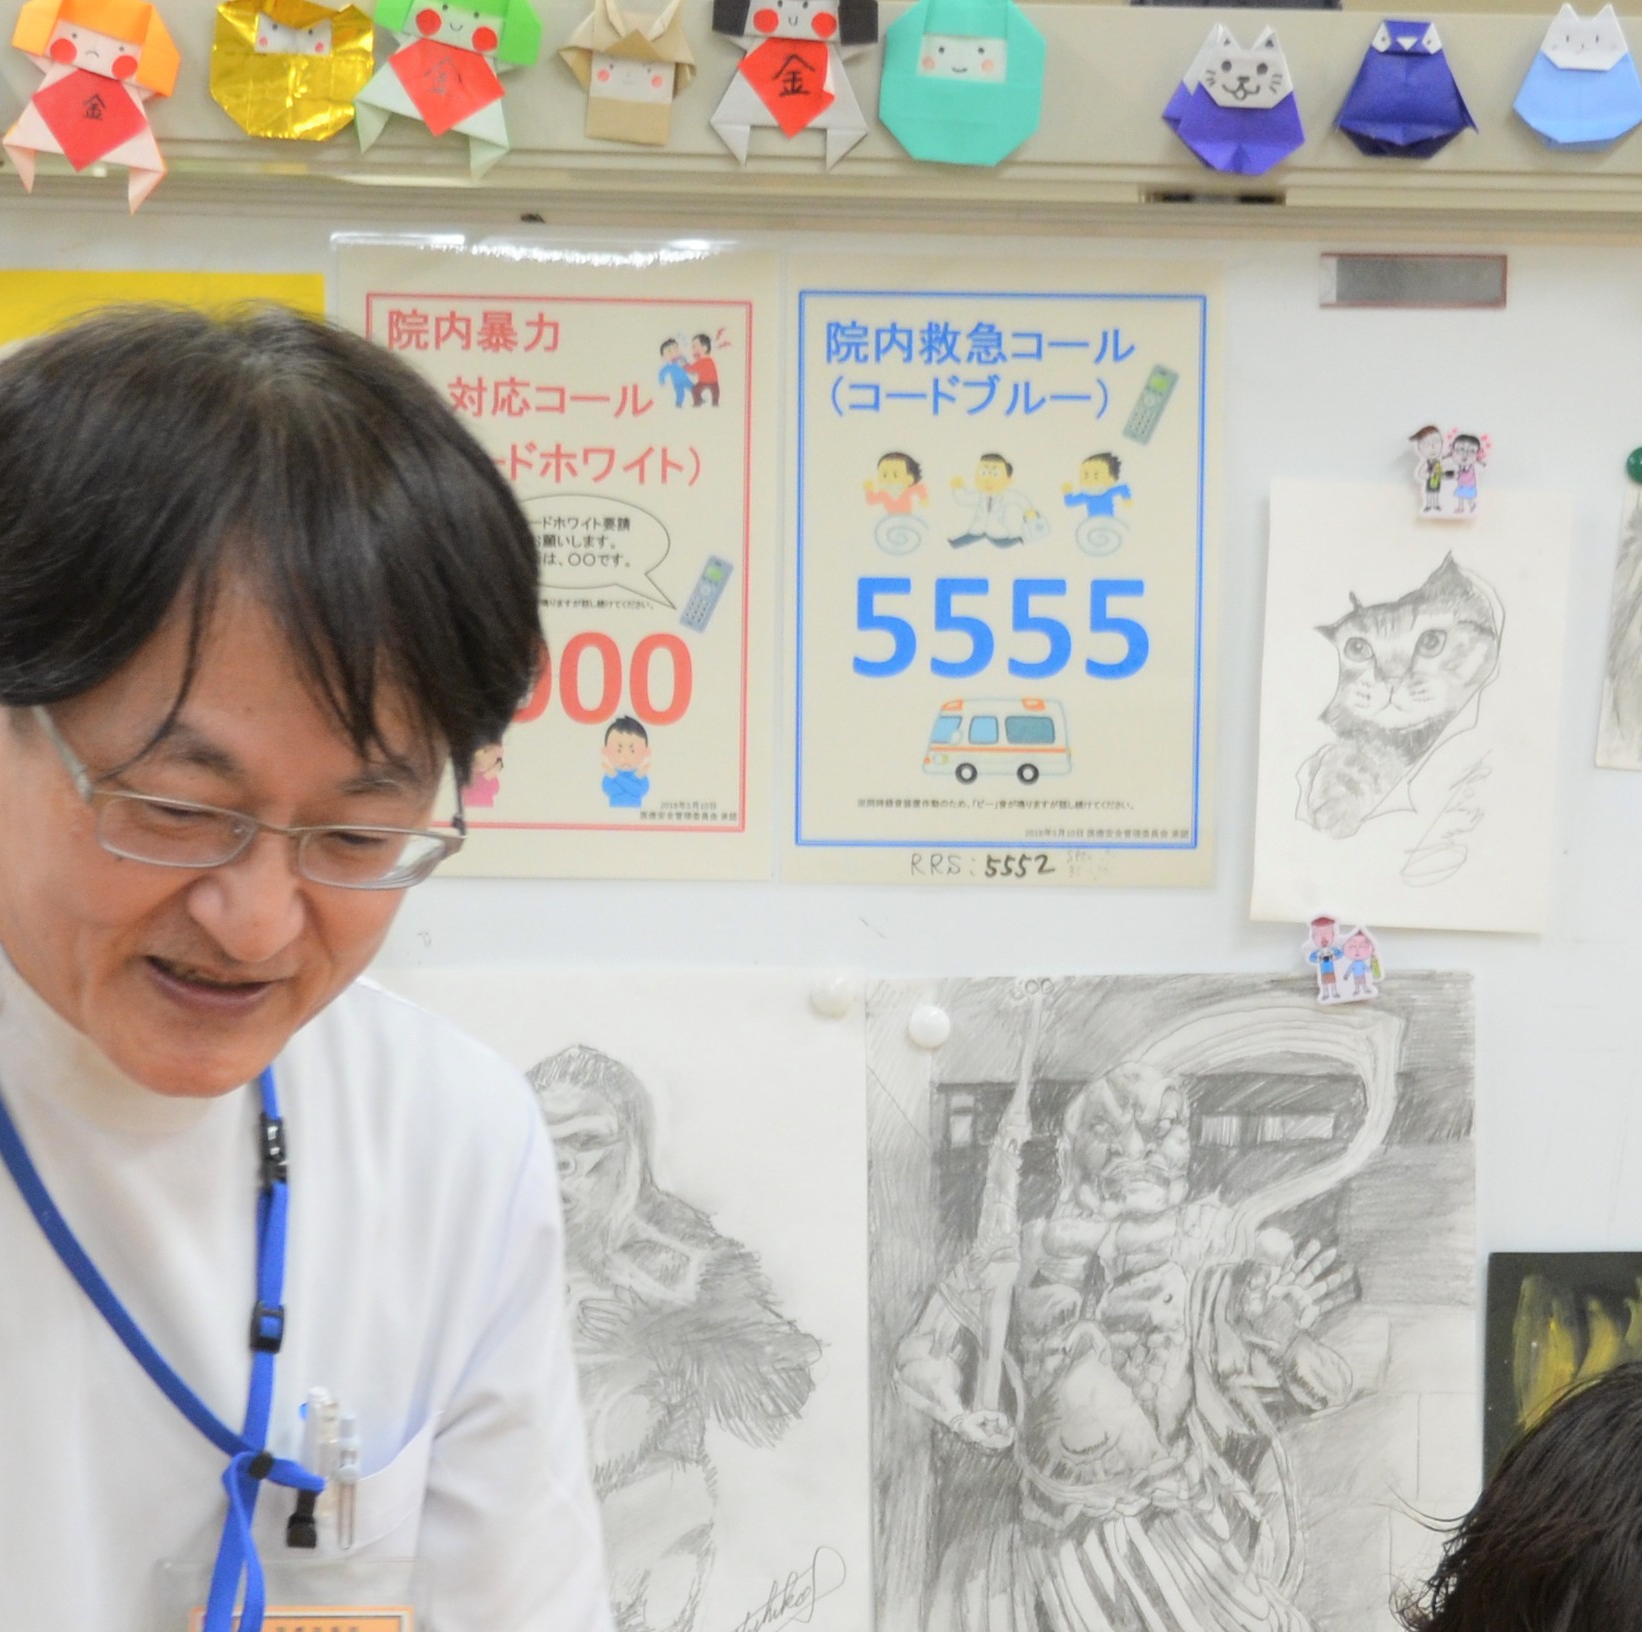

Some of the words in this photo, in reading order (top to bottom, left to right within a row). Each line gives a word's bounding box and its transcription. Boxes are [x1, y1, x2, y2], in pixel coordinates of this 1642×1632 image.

[773, 54, 814, 96] 金
[84, 93, 105, 120] 金
[386, 309, 559, 355] 院内暴力
[826, 320, 1135, 365] 院内救急コール
[445, 376, 653, 422] 対応コール
[831, 373, 1108, 418] （コードブルー）
[500, 443, 701, 486] ドホワイト）
[853, 577, 1149, 679] 5555
[985, 854, 1055, 878] 5552
